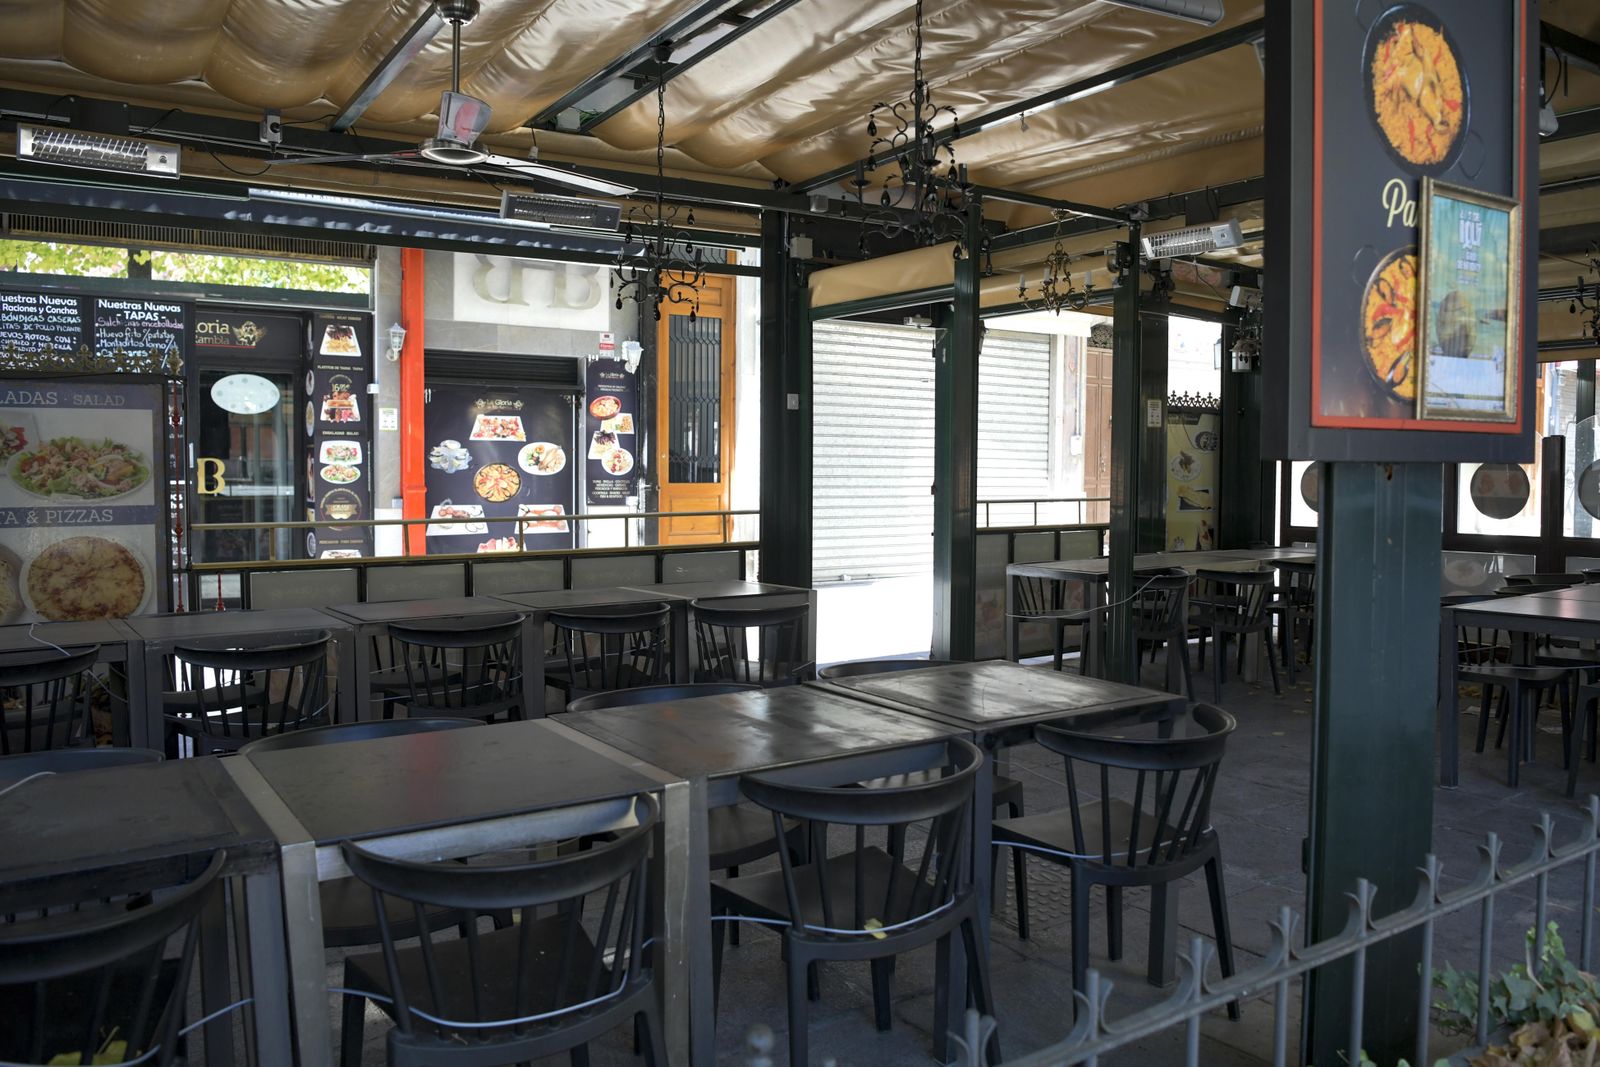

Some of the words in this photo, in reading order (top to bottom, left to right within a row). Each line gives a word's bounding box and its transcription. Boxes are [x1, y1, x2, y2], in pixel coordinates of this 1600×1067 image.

[1382, 178, 1417, 228] Pa
[0, 295, 37, 304] uestras
[39, 295, 77, 306] Nuevas
[98, 299, 142, 310] Nuestras
[144, 302, 181, 312] Nuevas
[2, 303, 37, 313] Raciones
[45, 306, 78, 315] Conchas
[123, 311, 159, 321] TAPAS
[0, 391, 58, 405] ADAS
[73, 394, 125, 406] SALAD
[27, 510, 39, 524] &
[46, 509, 113, 523] PIZZAS
